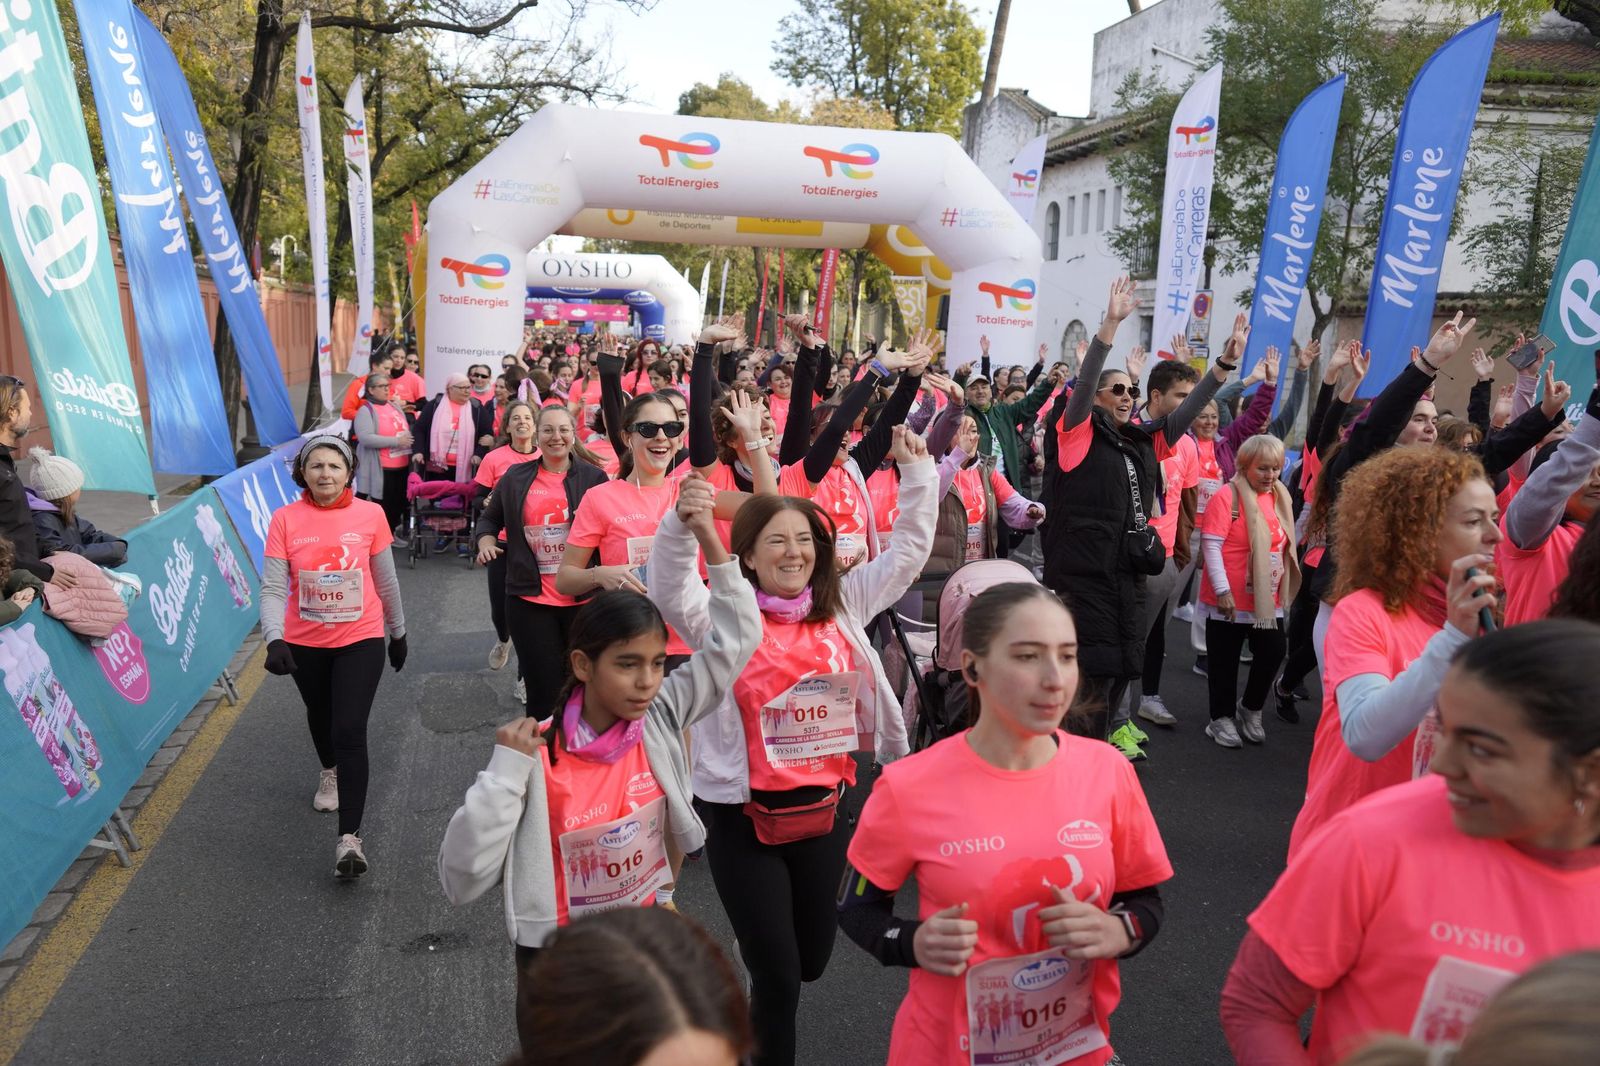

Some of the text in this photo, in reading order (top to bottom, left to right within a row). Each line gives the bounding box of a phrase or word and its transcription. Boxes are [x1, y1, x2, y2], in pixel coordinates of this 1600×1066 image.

[638, 174, 720, 191] TotalEnergies
[801, 184, 878, 200] TotalEnergies
[659, 220, 711, 231] de Deportes
[1381, 147, 1452, 308] Marlene
[1261, 186, 1315, 322] Marlene
[543, 258, 632, 278] OYSHO
[439, 294, 509, 309] TotalEnergies
[436, 345, 507, 358] totalenergies.es
[1131, 485, 1142, 508] LOLA
[293, 536, 320, 546] OYSHO
[544, 543, 566, 553] 016
[320, 592, 344, 602] 016
[119, 661, 145, 690] ESPAÑA
[795, 705, 828, 723] 016
[803, 726, 820, 735] 5373
[775, 736, 797, 744] CARRERA
[772, 746, 804, 755] OYSHO
[564, 803, 608, 828] OYSHO
[940, 835, 1006, 857] OYSHO
[607, 849, 644, 878] 016
[619, 875, 637, 889] 5372
[585, 894, 610, 904] CARRERA
[1430, 920, 1526, 958] OYSHO
[978, 980, 1009, 990] SUMA
[1018, 967, 1069, 987] ASTURIANA
[1021, 996, 1067, 1029] 016
[993, 1049, 1025, 1064] CARRERA
